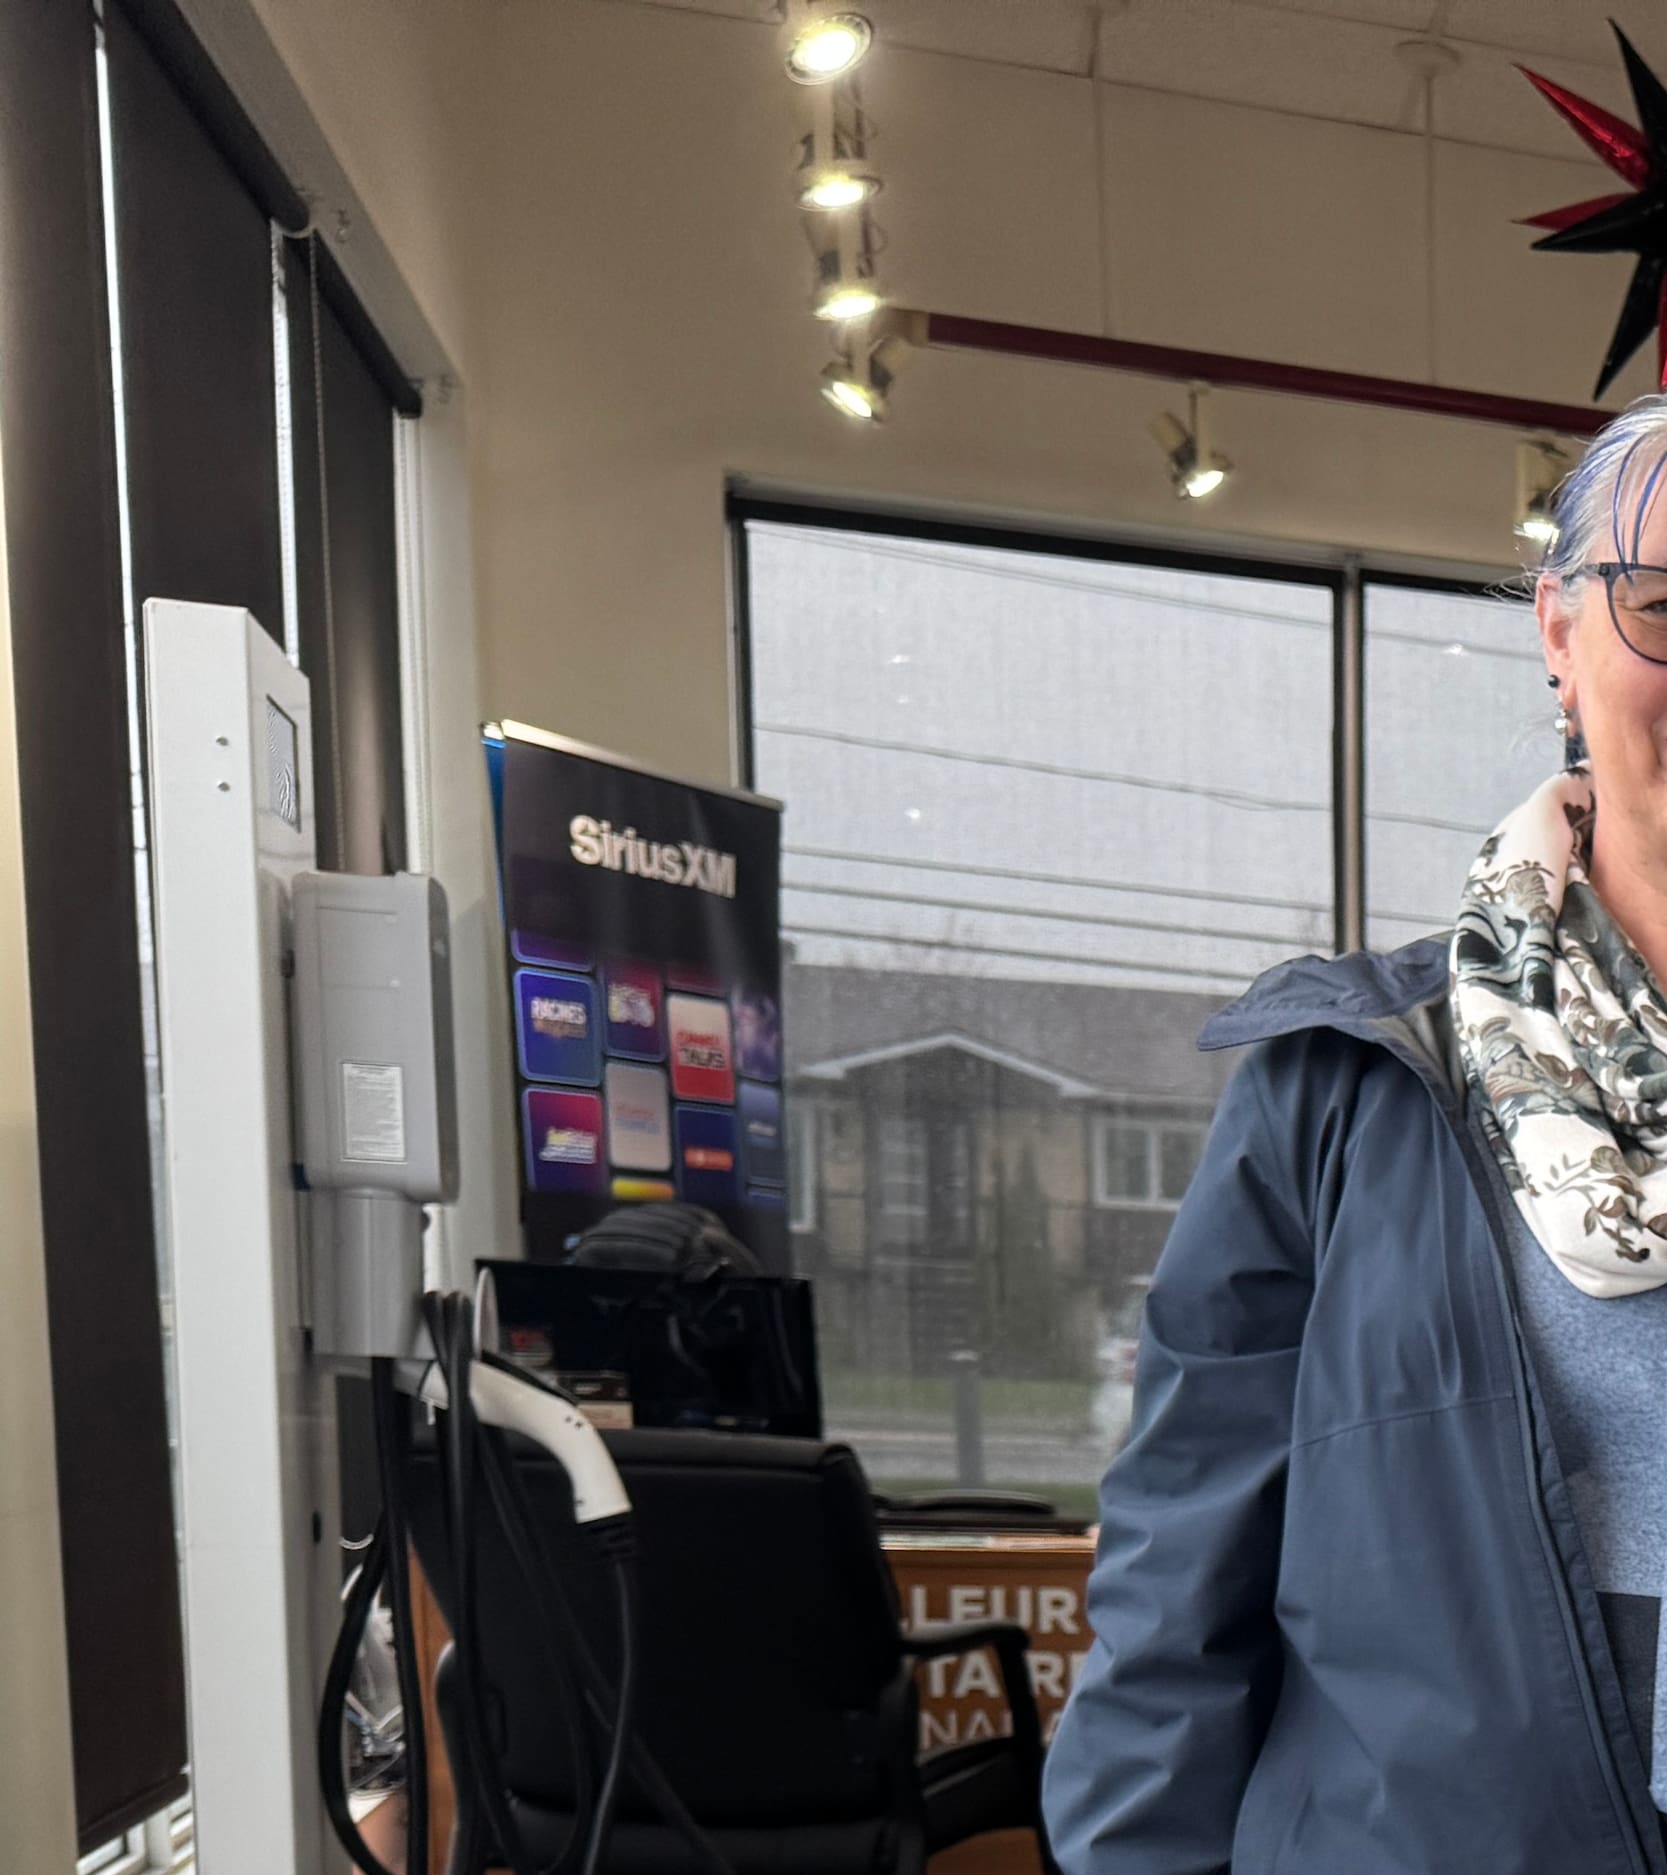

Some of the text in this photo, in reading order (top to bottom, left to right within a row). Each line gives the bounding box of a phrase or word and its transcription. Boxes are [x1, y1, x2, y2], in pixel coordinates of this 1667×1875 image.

[570, 814, 736, 899] SiriusXM
[900, 1585, 1080, 1634] LEUR
[926, 1650, 1090, 1699] TAR
